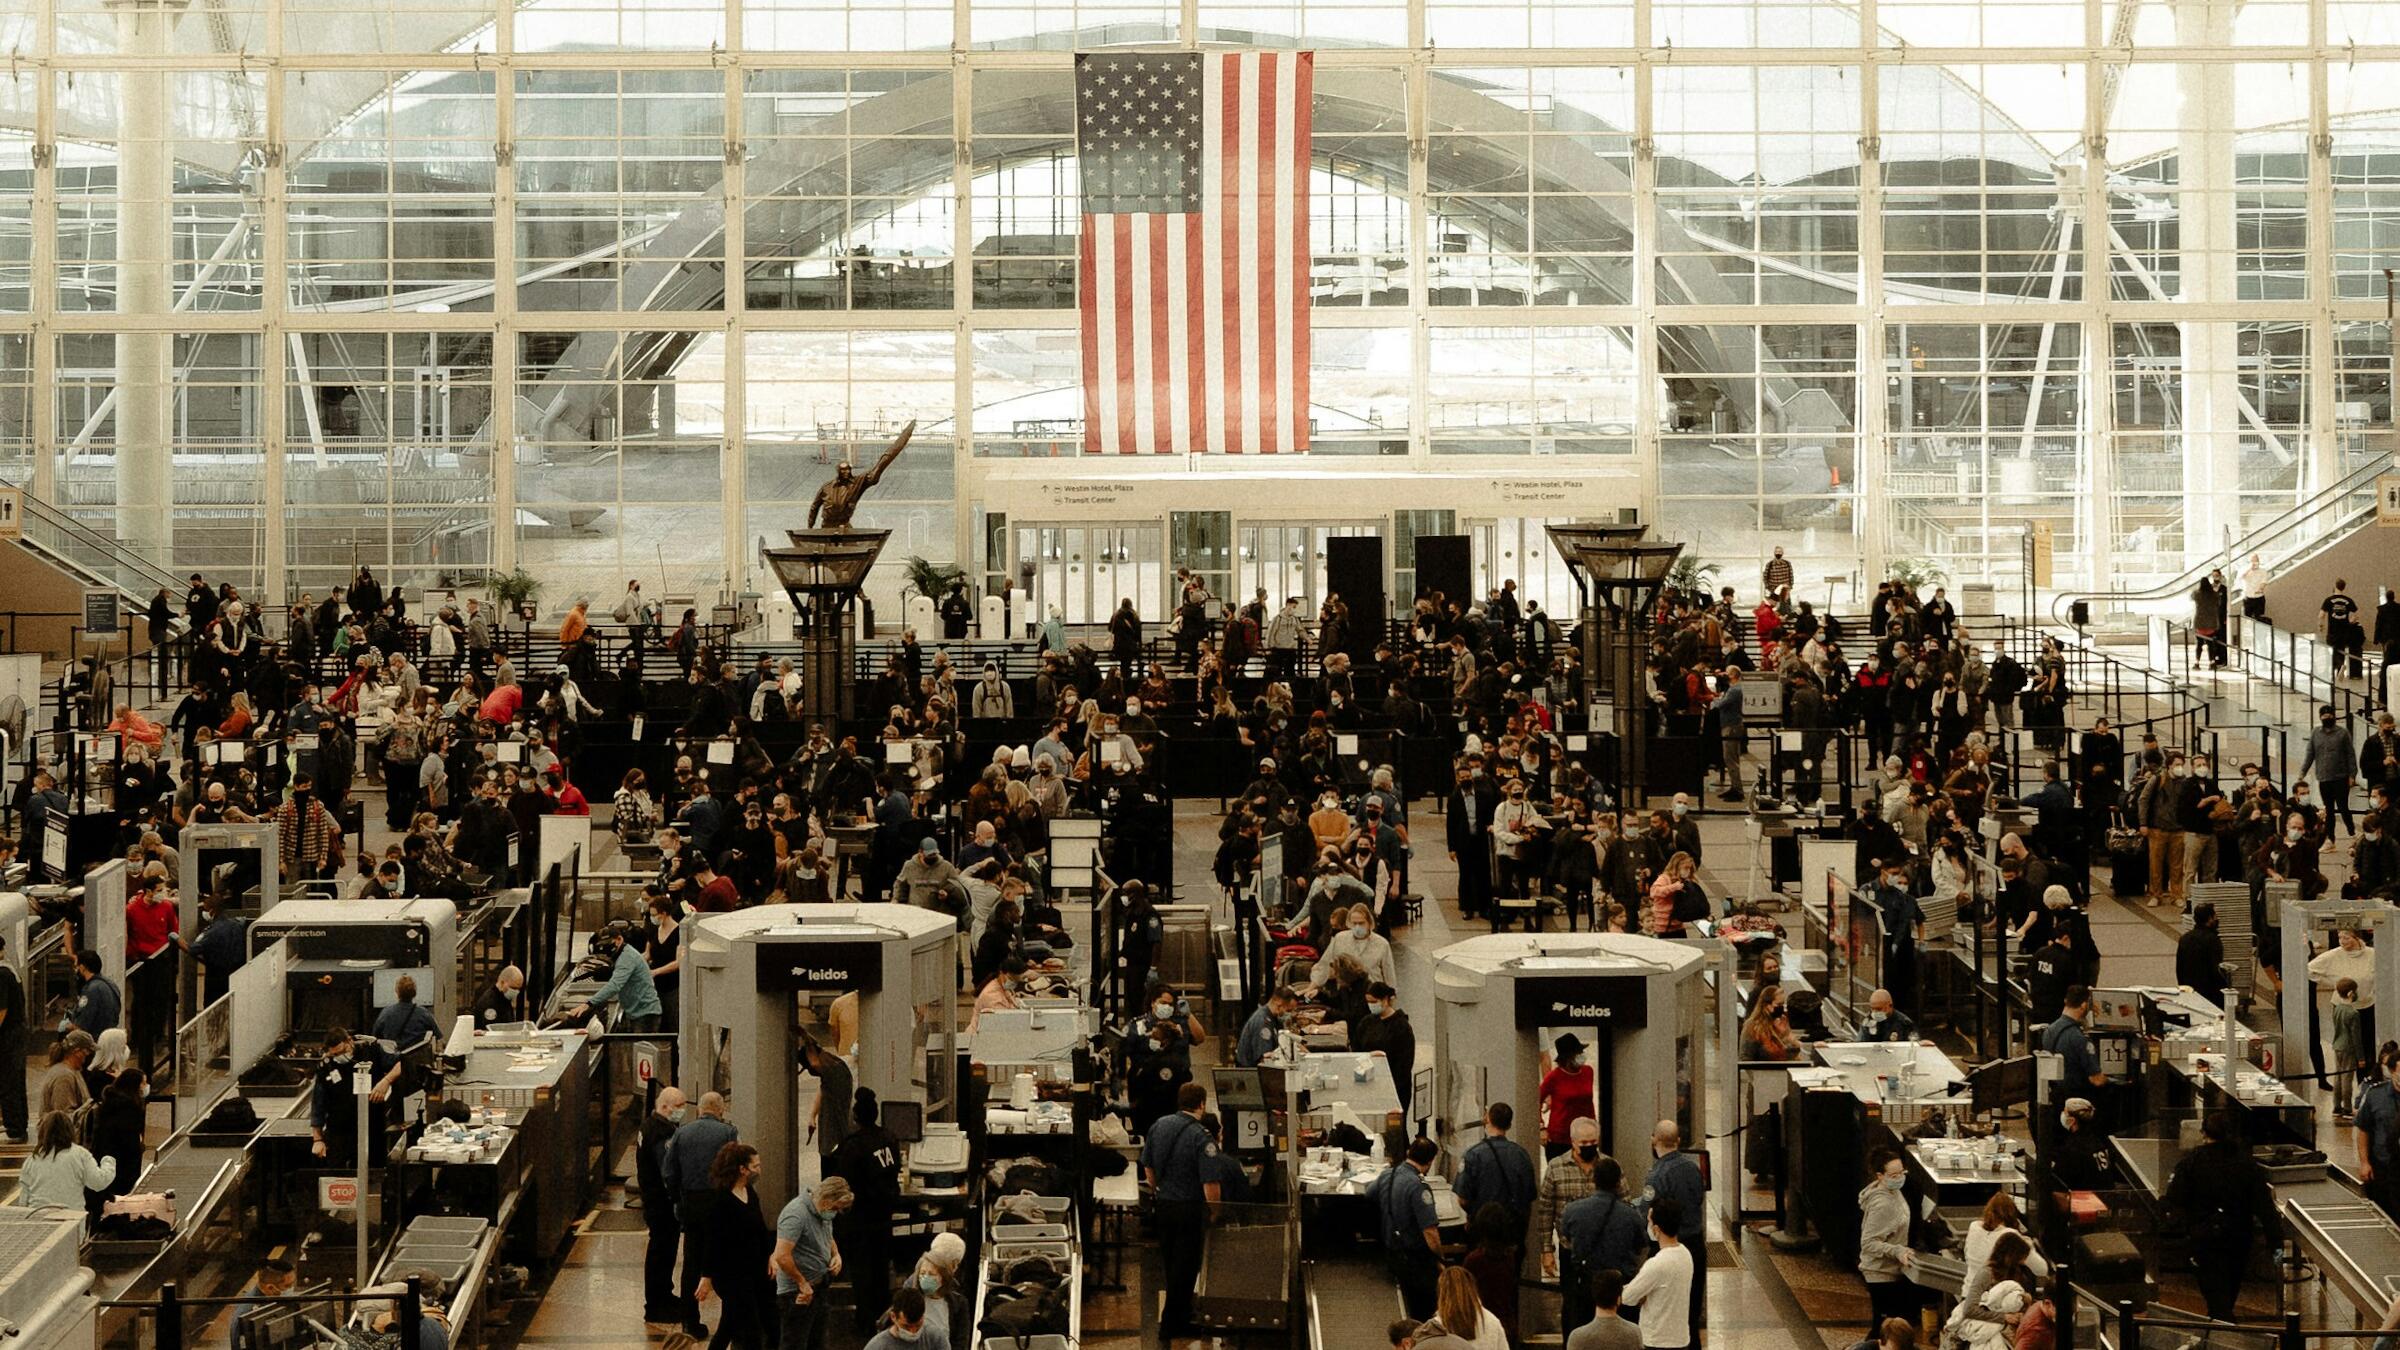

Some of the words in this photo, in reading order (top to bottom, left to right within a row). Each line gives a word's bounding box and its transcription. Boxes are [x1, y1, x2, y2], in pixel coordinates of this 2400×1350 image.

[1064, 484, 1090, 493] Westin
[1091, 484, 1113, 493] Hotel,
[1115, 484, 1134, 492] Plaza
[1514, 481, 1539, 489] Westin
[1541, 481, 1562, 489] Hotel,
[807, 967, 849, 981] leidos
[2037, 960, 2054, 975] TSA
[1569, 1003, 1612, 1017] leidos
[413, 1098, 424, 1111] 7
[1247, 1120, 1258, 1137] 9
[872, 1146, 895, 1168] TA
[331, 1188, 355, 1197] STOP
